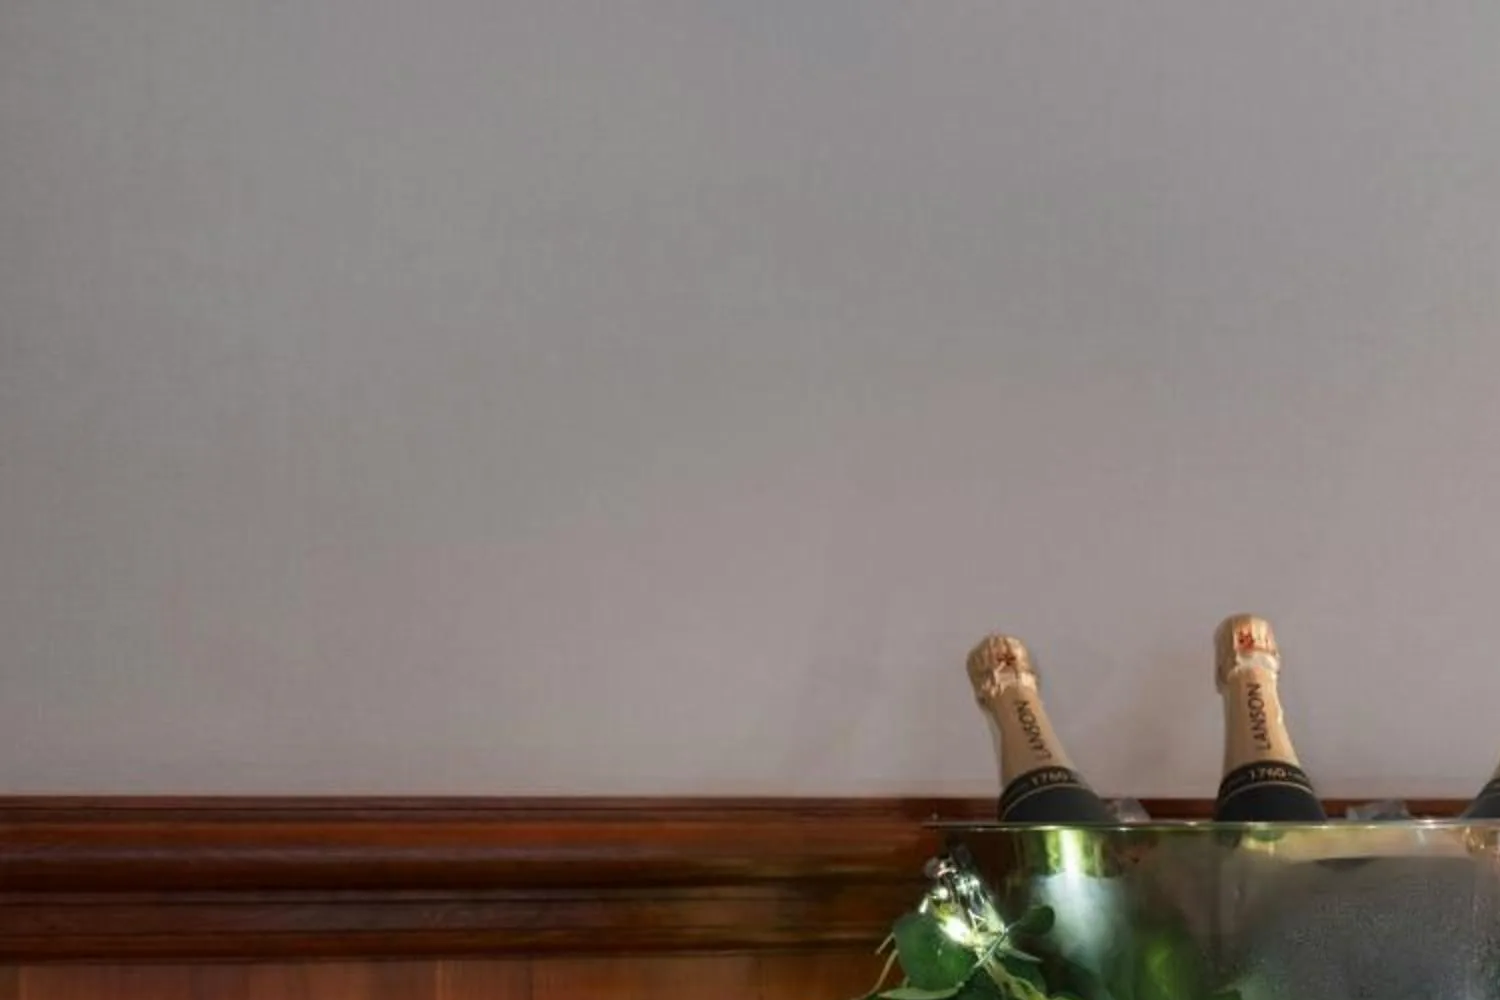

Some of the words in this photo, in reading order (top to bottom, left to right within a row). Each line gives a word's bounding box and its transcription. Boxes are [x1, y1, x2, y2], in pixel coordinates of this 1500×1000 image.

[1014, 699, 1053, 762] LANSON
[1246, 682, 1271, 750] LANSON
[1031, 769, 1069, 786] 1760
[1248, 767, 1287, 782] 1760
